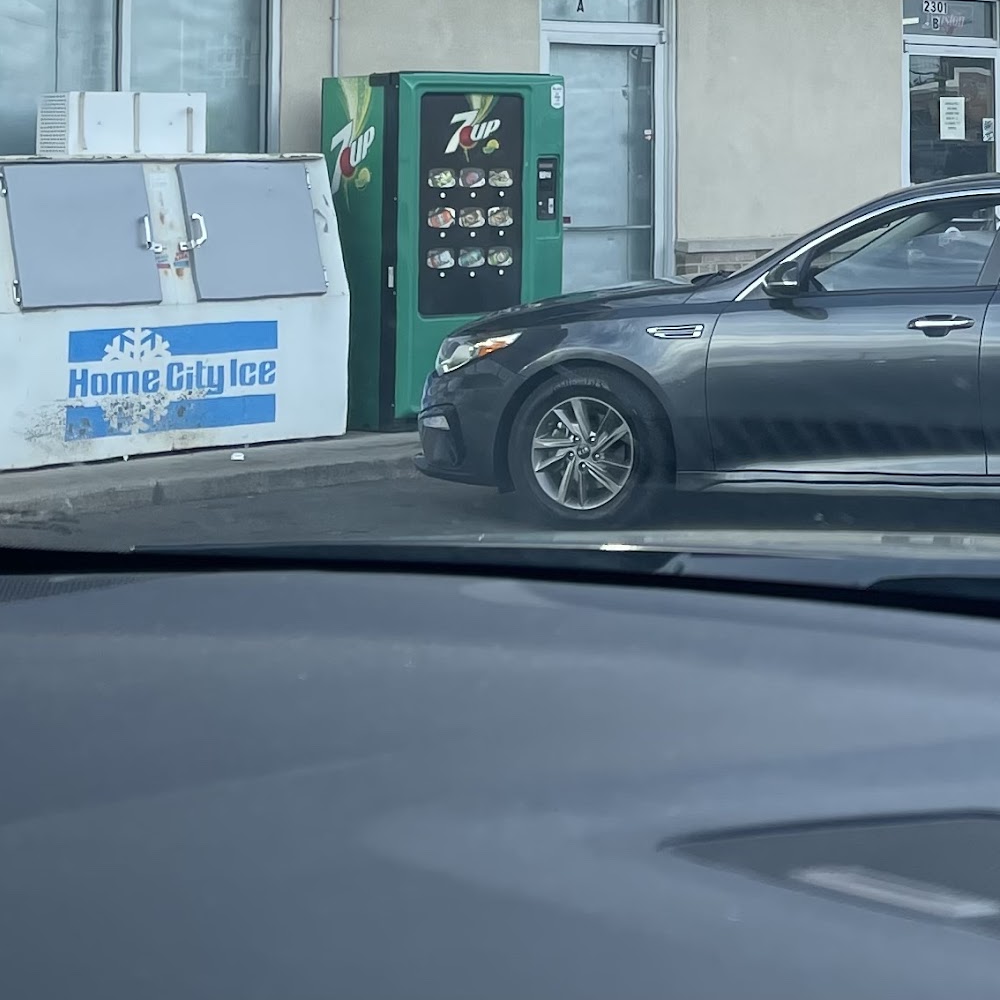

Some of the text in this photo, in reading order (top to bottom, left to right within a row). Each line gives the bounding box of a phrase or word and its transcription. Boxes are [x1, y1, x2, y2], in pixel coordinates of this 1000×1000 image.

[923, 0, 947, 14] 2301
[932, 17, 940, 30] B
[68, 358, 276, 398] Home City Ice
